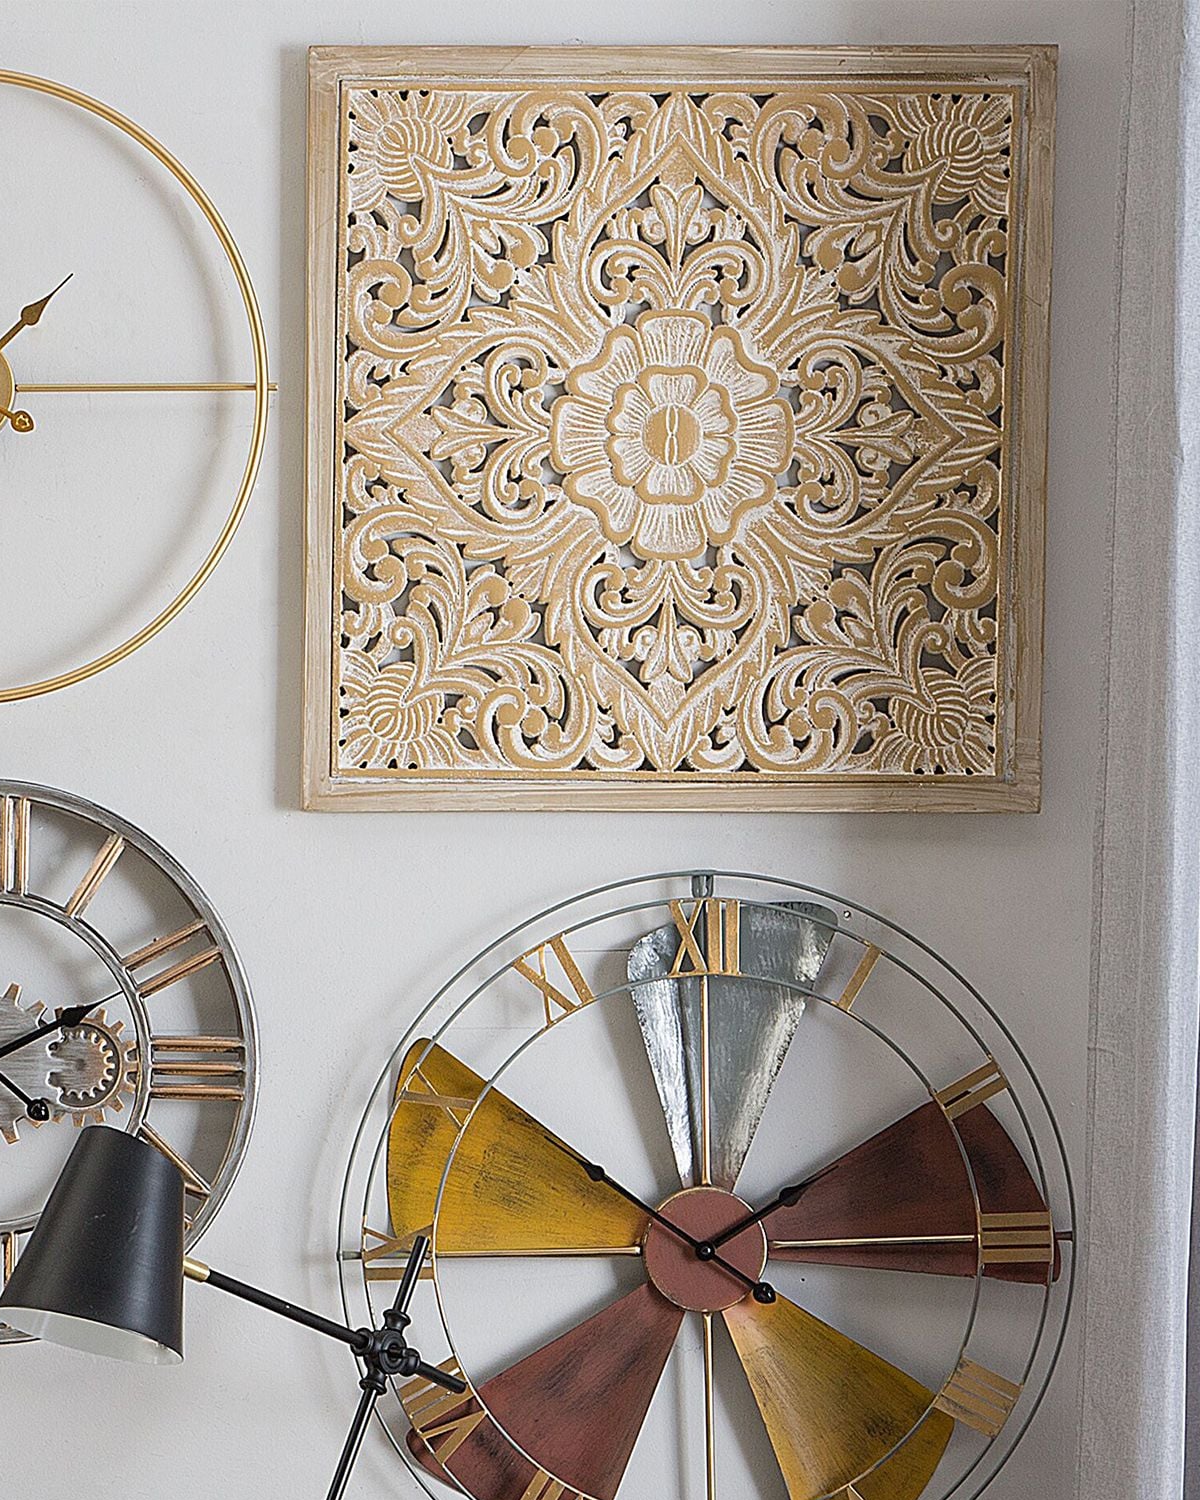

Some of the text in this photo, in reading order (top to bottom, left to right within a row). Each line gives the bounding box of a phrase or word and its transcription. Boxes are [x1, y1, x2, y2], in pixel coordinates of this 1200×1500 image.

[120, 919, 222, 998] II
[668, 898, 743, 976] XII
[512, 932, 596, 1028] XI
[149, 1033, 244, 1101] III
[401, 1066, 477, 1130] X
[933, 1060, 1010, 1120] II
[978, 1211, 1054, 1265] III
